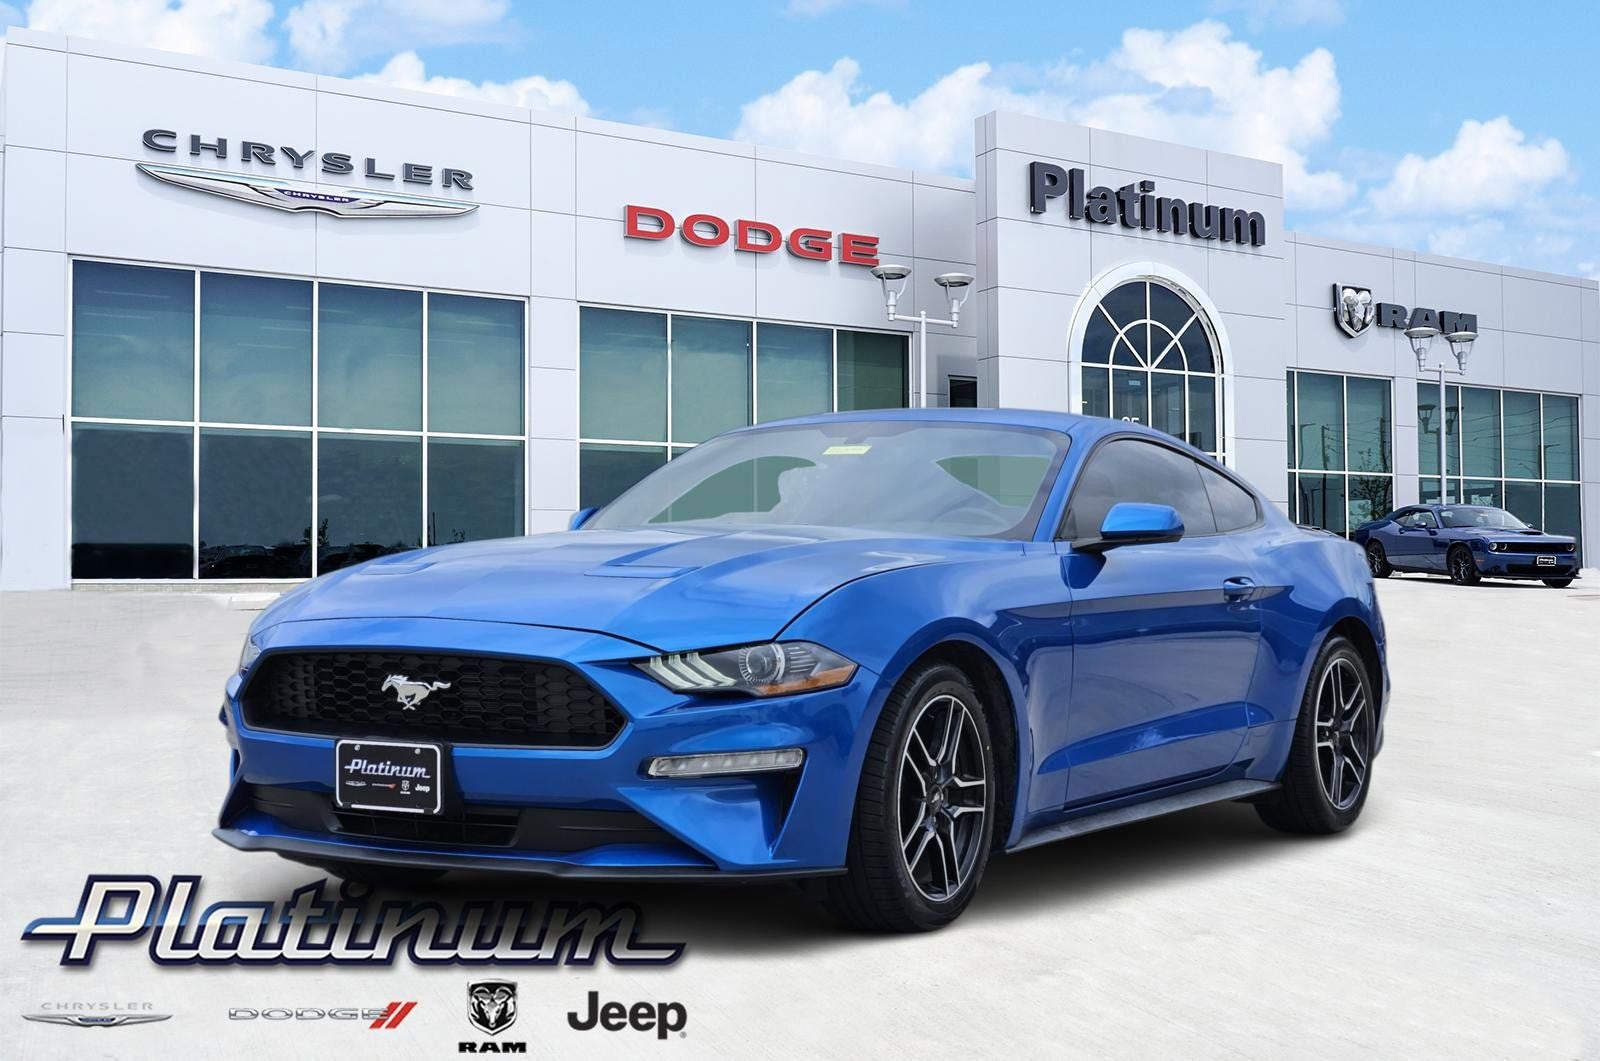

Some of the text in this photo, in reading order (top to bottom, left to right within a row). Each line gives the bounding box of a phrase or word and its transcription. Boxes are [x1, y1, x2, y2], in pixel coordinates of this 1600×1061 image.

[142, 128, 473, 190] CHRYSLER
[1029, 160, 1267, 247] Platinum
[624, 204, 881, 267] DODGE
[1376, 302, 1478, 335] RAM
[344, 758, 431, 779] Platinum
